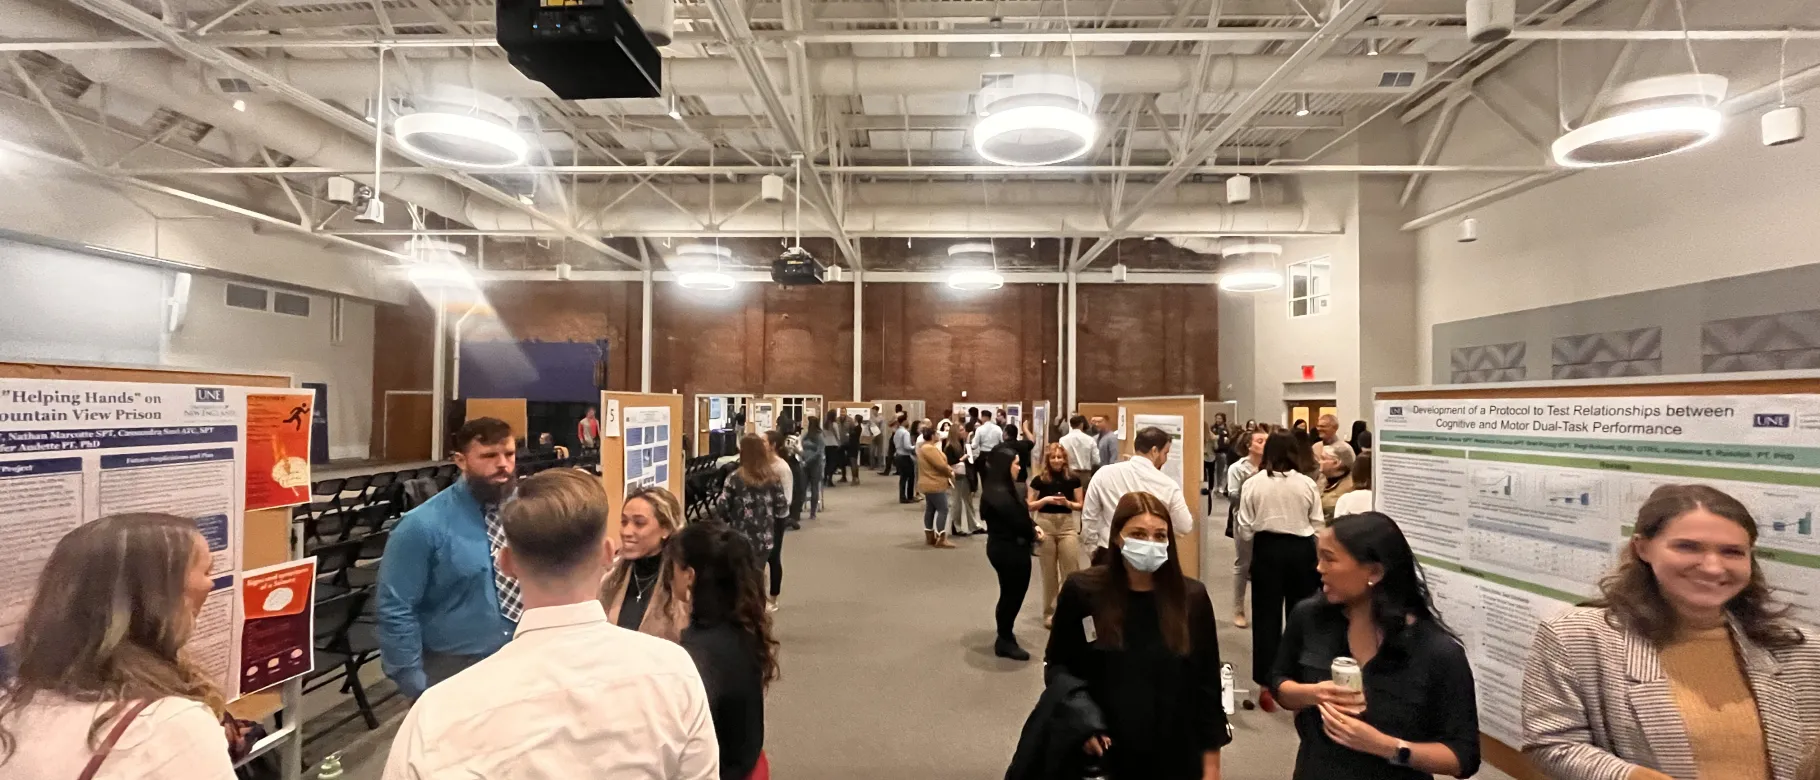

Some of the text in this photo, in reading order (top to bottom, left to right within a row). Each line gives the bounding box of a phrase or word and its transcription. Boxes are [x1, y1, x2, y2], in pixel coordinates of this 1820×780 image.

[2, 390, 162, 406] "Helping Hands" on
[198, 389, 222, 401] UNE
[72, 408, 112, 421] View
[115, 409, 162, 420] Prison
[610, 408, 615, 422] 5
[1412, 405, 1734, 419] Development of a Protocol to Test Relationships between
[1435, 418, 1683, 435] Cognitive and Motor Dual-Task Performance
[8, 432, 48, 441] Nathan
[80, 440, 100, 449] PhD
